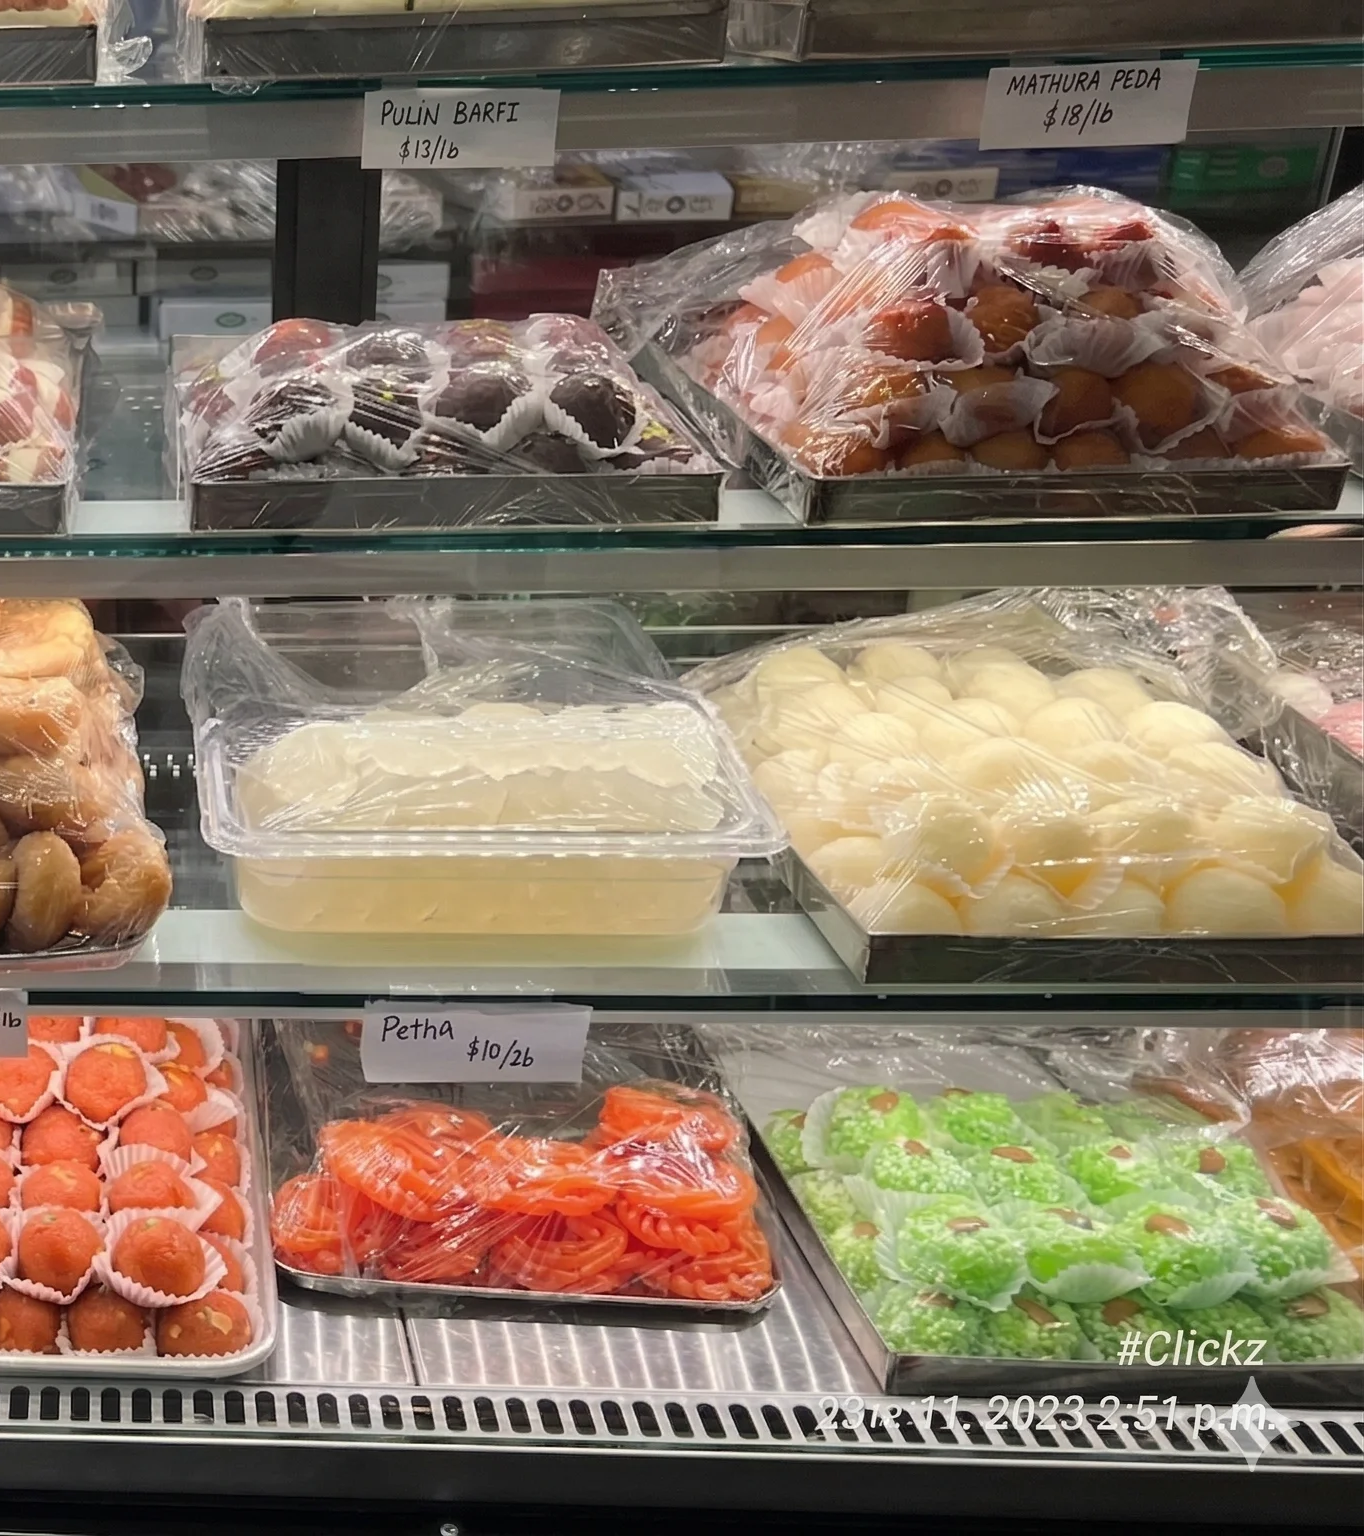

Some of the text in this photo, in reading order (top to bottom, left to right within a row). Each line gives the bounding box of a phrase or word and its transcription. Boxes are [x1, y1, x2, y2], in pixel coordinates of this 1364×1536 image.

[1006, 67, 1162, 96] MATHURA PEDA
[453, 101, 520, 125] BARFI
[381, 1015, 455, 1042] Petha
